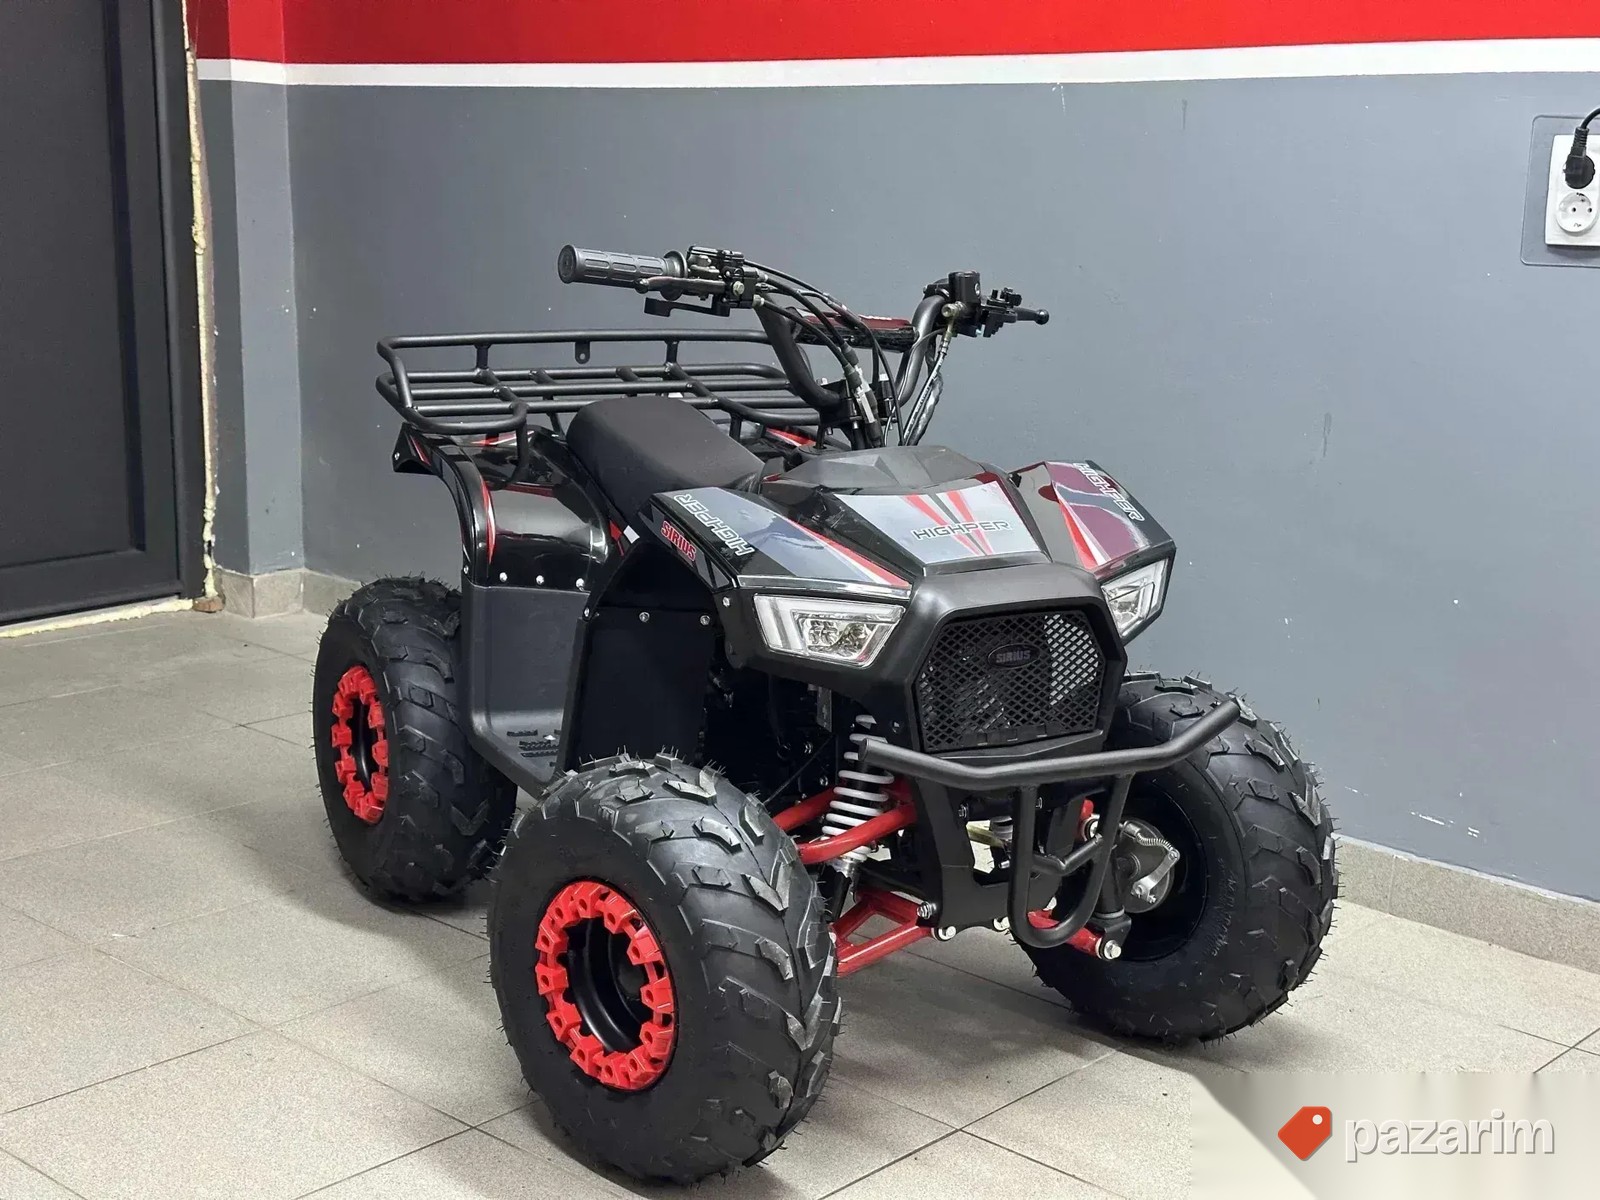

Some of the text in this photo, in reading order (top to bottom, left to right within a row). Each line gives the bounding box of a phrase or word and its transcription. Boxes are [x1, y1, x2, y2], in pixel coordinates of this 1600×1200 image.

[1073, 463, 1145, 521] HIGHPER
[661, 520, 697, 561] SIRIUS
[674, 493, 755, 556] HIGHPER
[911, 520, 1012, 541] HIGHPER
